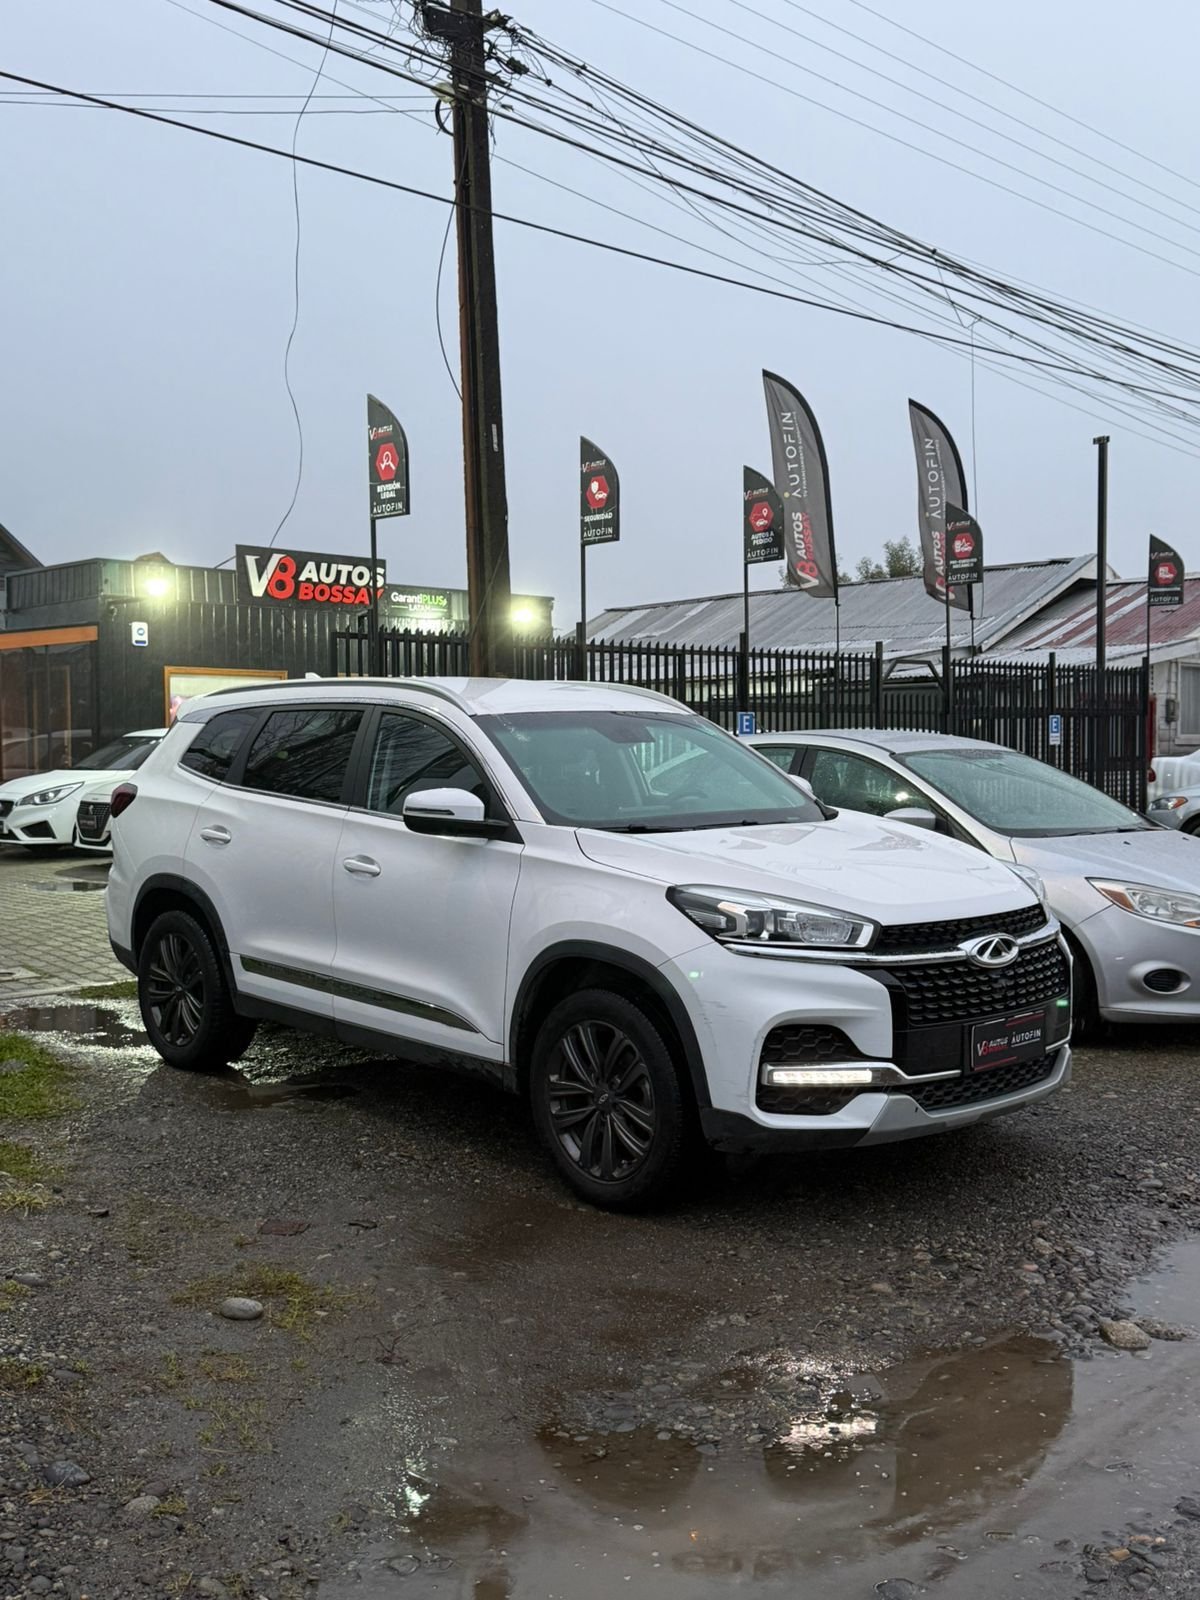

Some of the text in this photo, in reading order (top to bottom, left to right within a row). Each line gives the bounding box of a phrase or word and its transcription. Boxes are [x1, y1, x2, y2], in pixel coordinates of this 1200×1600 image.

[781, 412, 802, 498] AUTOFIN
[924, 438, 942, 519] AUTOFIN
[373, 501, 403, 513] AUTOFIN
[584, 512, 613, 522] SEGURIDAD
[583, 527, 613, 538] AUTOFIN
[792, 512, 807, 559] AUTOS
[747, 547, 778, 558] AUTOFIN
[931, 531, 945, 576] AUTOS
[245, 553, 297, 600] V8
[298, 561, 385, 588] AUTOS
[795, 561, 819, 589] V8
[948, 572, 978, 581] AUTOFIN
[391, 591, 445, 606] GarantiPLUS
[743, 715, 751, 732] E
[1052, 718, 1058, 732] E
[1011, 1029, 1041, 1044] AUTOFIN
